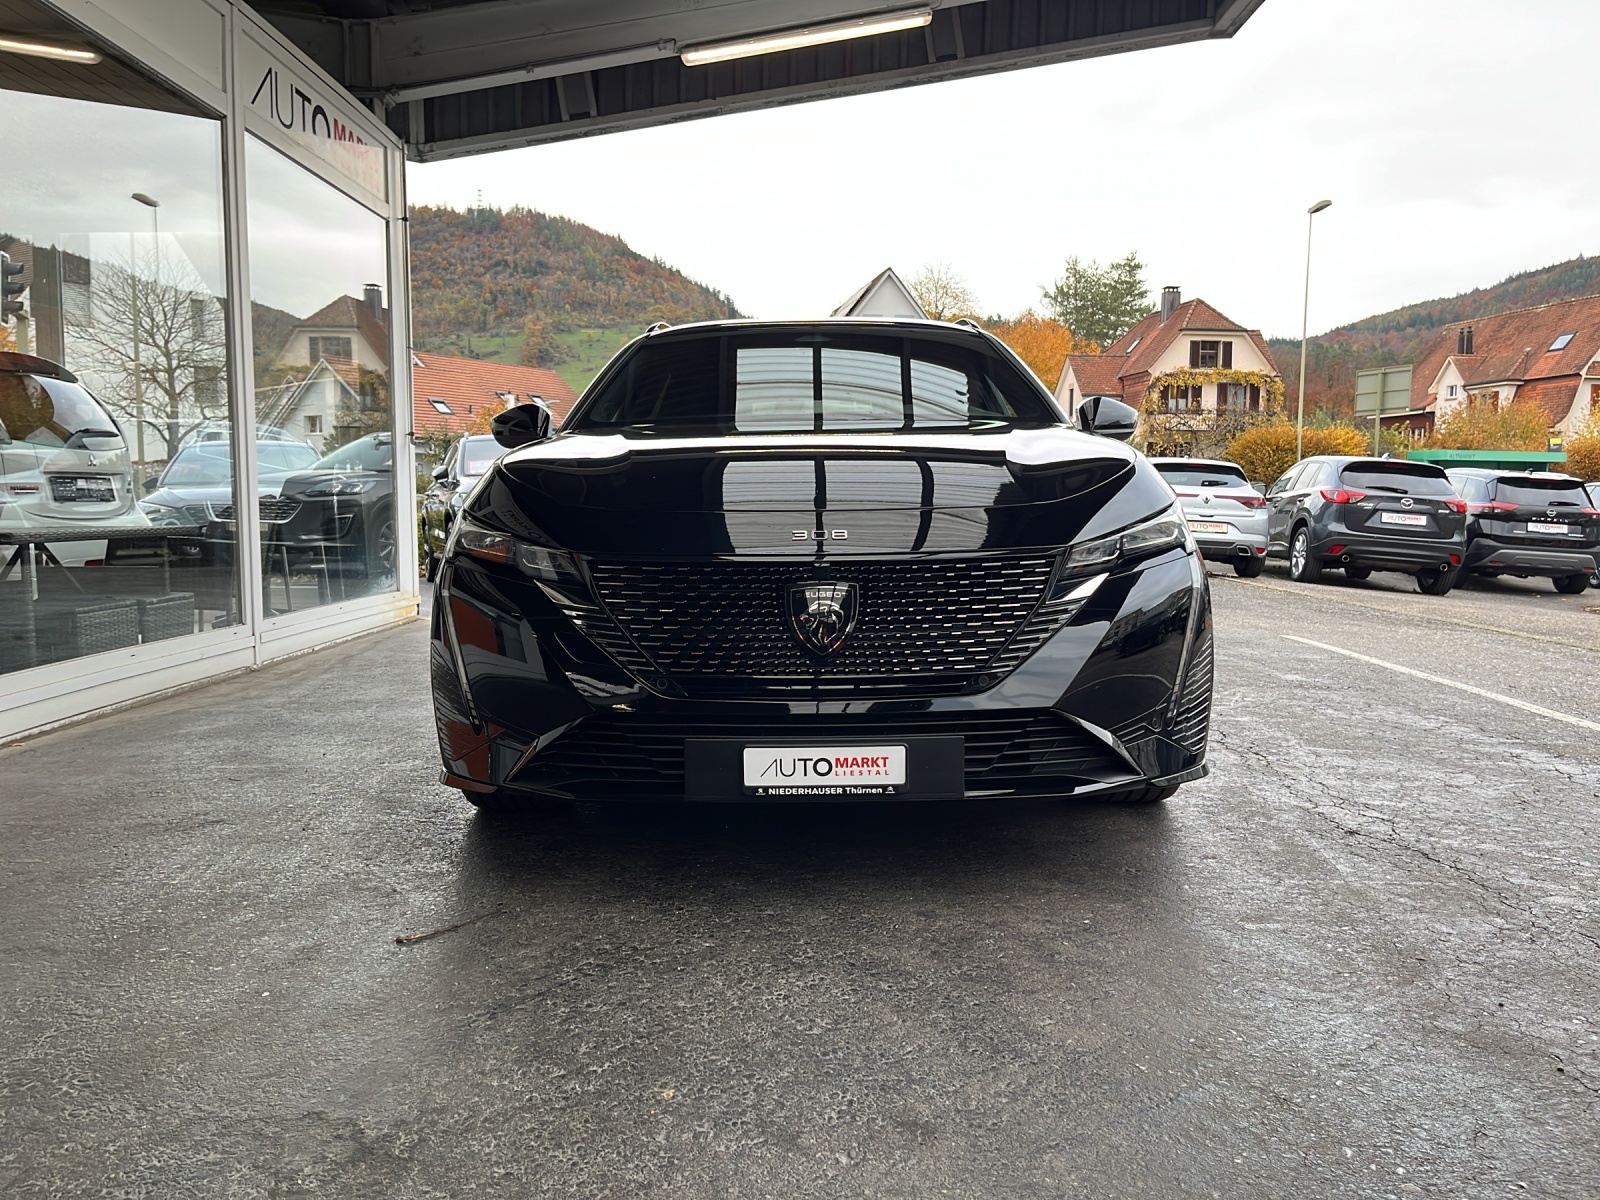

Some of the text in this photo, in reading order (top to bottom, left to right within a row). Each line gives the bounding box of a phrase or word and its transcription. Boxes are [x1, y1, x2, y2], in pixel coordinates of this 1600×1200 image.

[251, 67, 331, 141] AUTO
[792, 529, 848, 540] 308
[760, 756, 889, 778] AUTO MARKT
[835, 769, 889, 777] LIESTAL
[768, 786, 883, 795] NIEDERHAUSER Thürnen
